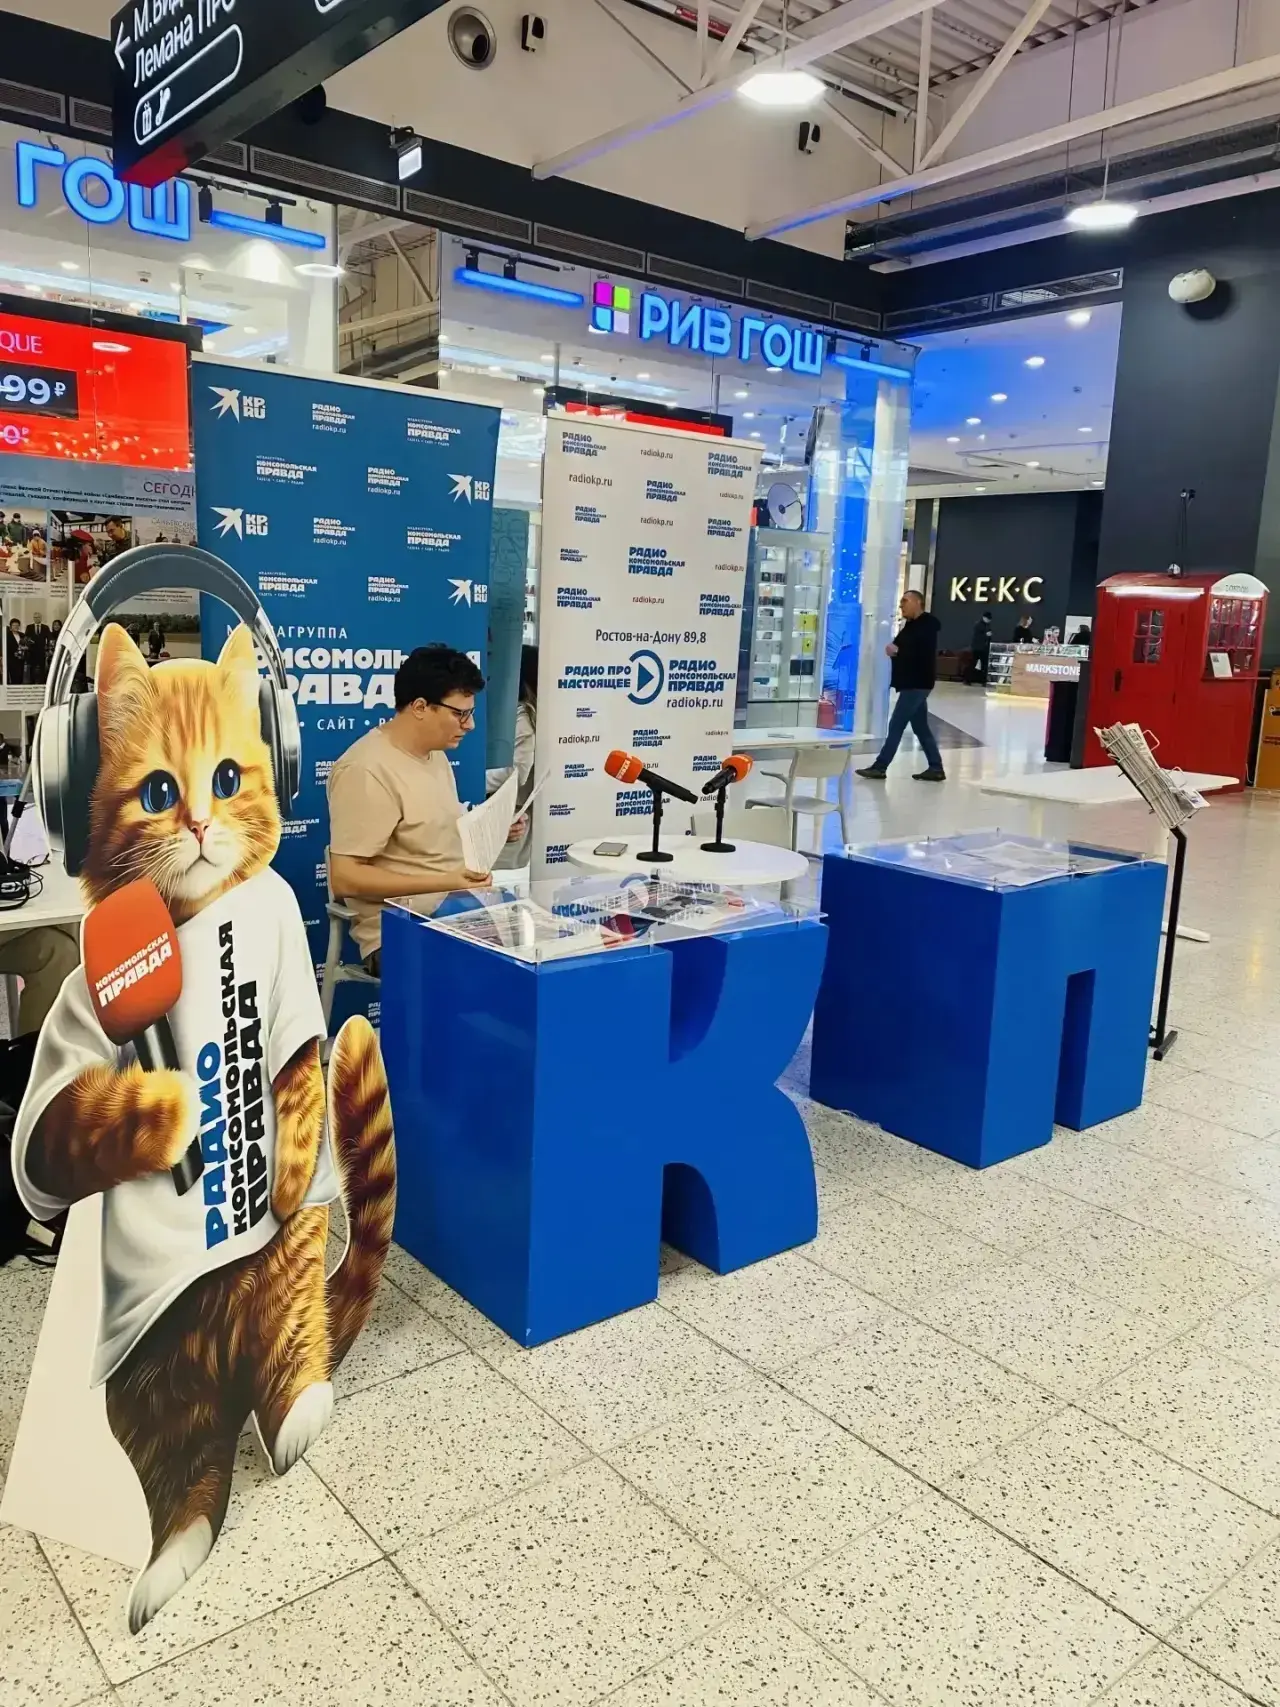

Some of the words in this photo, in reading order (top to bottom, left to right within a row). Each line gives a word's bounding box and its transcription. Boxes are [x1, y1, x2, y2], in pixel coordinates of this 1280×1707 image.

[134, 14, 193, 88] Лемана
[198, 0, 236, 34] Про
[16, 140, 191, 242] ГОШ
[640, 292, 733, 356] РИВ
[738, 315, 823, 375] ГОШ
[312, 403, 341, 412] РАДИО
[243, 407, 266, 419] RU
[312, 410, 355, 420] КОМСОМОЛЬСКАЯ
[312, 414, 346, 424] ПРАВДА
[312, 424, 346, 434] radiokp.ru
[407, 422, 461, 434] КОМСОМОЛЬСКАЯ
[407, 428, 450, 440] ПРАВДА
[562, 432, 592, 442] РАДИО
[562, 440, 606, 450] КОМСОМОЛЬСКАЯ
[562, 446, 598, 456] ПРАВДА
[640, 449, 673, 460] radiokp.ru
[708, 452, 738, 463] РАДИО
[256, 460, 317, 472] КОМСОМОЛЬСКАЯ
[708, 462, 752, 472] КОМСОМОЛЬСКАЯ
[256, 466, 304, 479] ПРАВДА
[368, 467, 395, 476] РАДИО
[708, 467, 743, 478] ПРАВДА
[368, 474, 409, 482] КОМСОМОЛЬСКАЯ
[368, 478, 400, 487] ПРАВДА
[568, 474, 612, 487] radiokp.ru
[647, 480, 673, 489] РАДИО
[368, 486, 400, 496] radiokp.ru
[474, 490, 490, 501] RU
[646, 488, 686, 496] КОМСОМОЛЬСКАЯ
[720, 492, 744, 500] radiokp.ru
[646, 492, 678, 502] ПРАВДА
[314, 517, 341, 526] РАДИО
[640, 516, 674, 527] radiokp.ru
[708, 518, 731, 526] РАДИО
[246, 524, 268, 536] RU
[314, 524, 356, 532] КОМСОМОЛЬСКАЯ
[314, 528, 346, 537] ПРАВДА
[408, 530, 461, 541] КОМСОМОЛЬСКАЯ
[707, 530, 736, 538] ПРАВДА
[314, 537, 346, 546] radiokp.ru
[408, 536, 450, 546] ПРАВДА
[629, 546, 667, 558] РАДИО
[628, 558, 686, 567] КОМСОМОЛЬСКАЯ
[628, 564, 674, 577] ПРАВДА
[259, 576, 318, 585] КОМСОМОЛЬСКАЯ
[368, 576, 395, 584] РАДИО
[259, 582, 304, 592] ПРАВДА
[368, 586, 400, 594] ПРАВДА
[557, 588, 588, 596] РАДИО
[368, 594, 400, 603] radiokp.ru
[474, 594, 488, 603] RU
[632, 596, 665, 604] radiokp.ru
[700, 594, 730, 602] РАДИО
[557, 600, 592, 610] ПРАВДА
[699, 608, 735, 617] ПРАВДА
[227, 625, 348, 639] АГРУППА
[596, 629, 682, 645] Ростов-на-Дону
[684, 632, 706, 644] 89,8
[565, 666, 604, 676] РАДИО
[608, 665, 632, 676] ПРО
[669, 660, 717, 672] РАДИО
[1026, 664, 1080, 676] MARKSTONE
[668, 672, 736, 680] КОМСОМОЛЬСКАЯ
[558, 678, 630, 690] НАСТОЯЩЕЕ
[668, 680, 724, 693] ПРАВДА
[666, 696, 723, 710] radiokp.ru
[317, 716, 355, 730] САЙТ
[558, 734, 600, 744] radiokp.ru
[692, 764, 721, 772] ПРАВДА
[616, 790, 653, 801] РАДИО
[616, 804, 656, 816] ПРАВД
[280, 818, 320, 826] ОМОЛЬСКАЯ
[546, 844, 570, 853] РАДИ
[95, 931, 169, 991] КОМСОМОЛЬСКАЯ
[98, 941, 173, 1008] ПРАВДА
[218, 920, 249, 1236] КОМСОМОЛЬСКАЯ
[238, 980, 269, 1229] ПРАВДА
[196, 1040, 229, 1251] РАДИО
